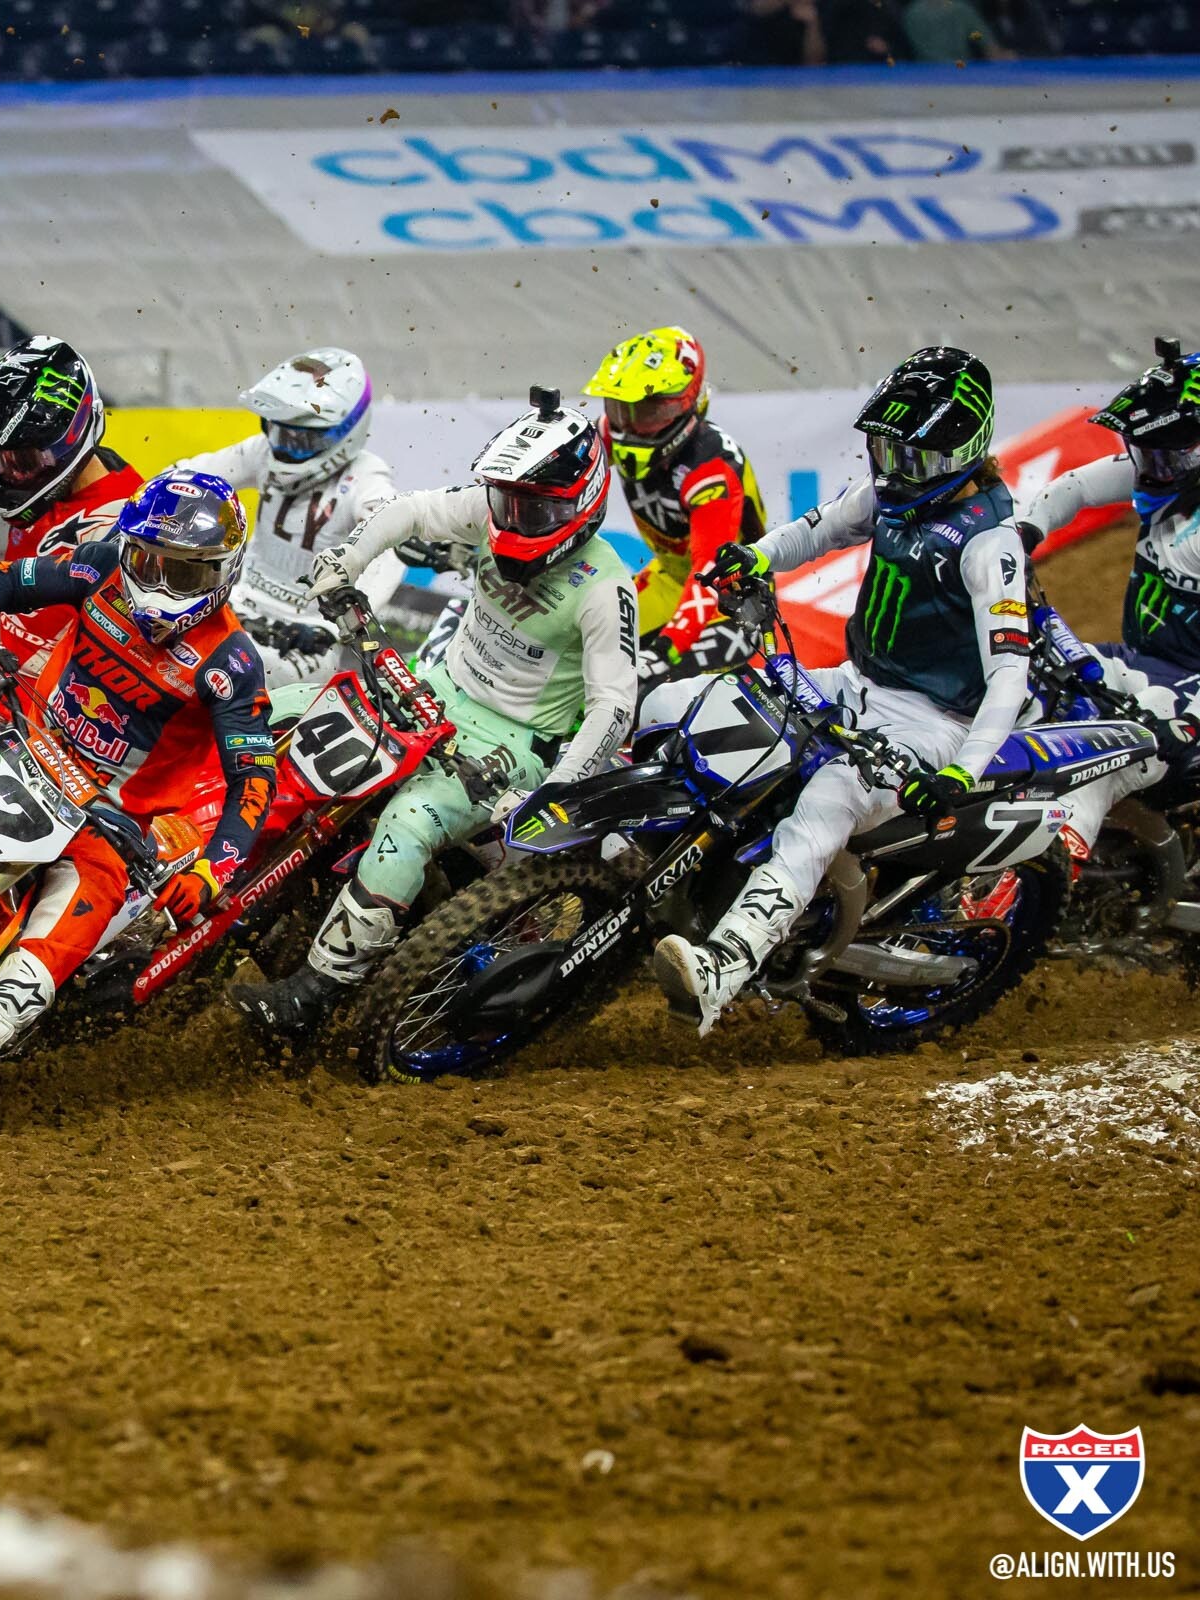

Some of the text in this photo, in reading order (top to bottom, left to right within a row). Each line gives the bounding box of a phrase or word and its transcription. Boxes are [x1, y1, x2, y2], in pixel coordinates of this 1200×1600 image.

[311, 135, 982, 187] cbdMD
[169, 484, 199, 497] BELL
[90, 608, 126, 642] MOTOREX
[176, 591, 216, 634] Red
[615, 585, 637, 668] LEATT
[72, 632, 162, 713] THOR
[52, 690, 128, 763] Red Bull
[295, 710, 383, 796] 40
[1069, 753, 1131, 786] DUNLOP
[966, 802, 1045, 873] 7
[148, 919, 213, 981] DUNLOP
[559, 906, 632, 978] DUNLOP
